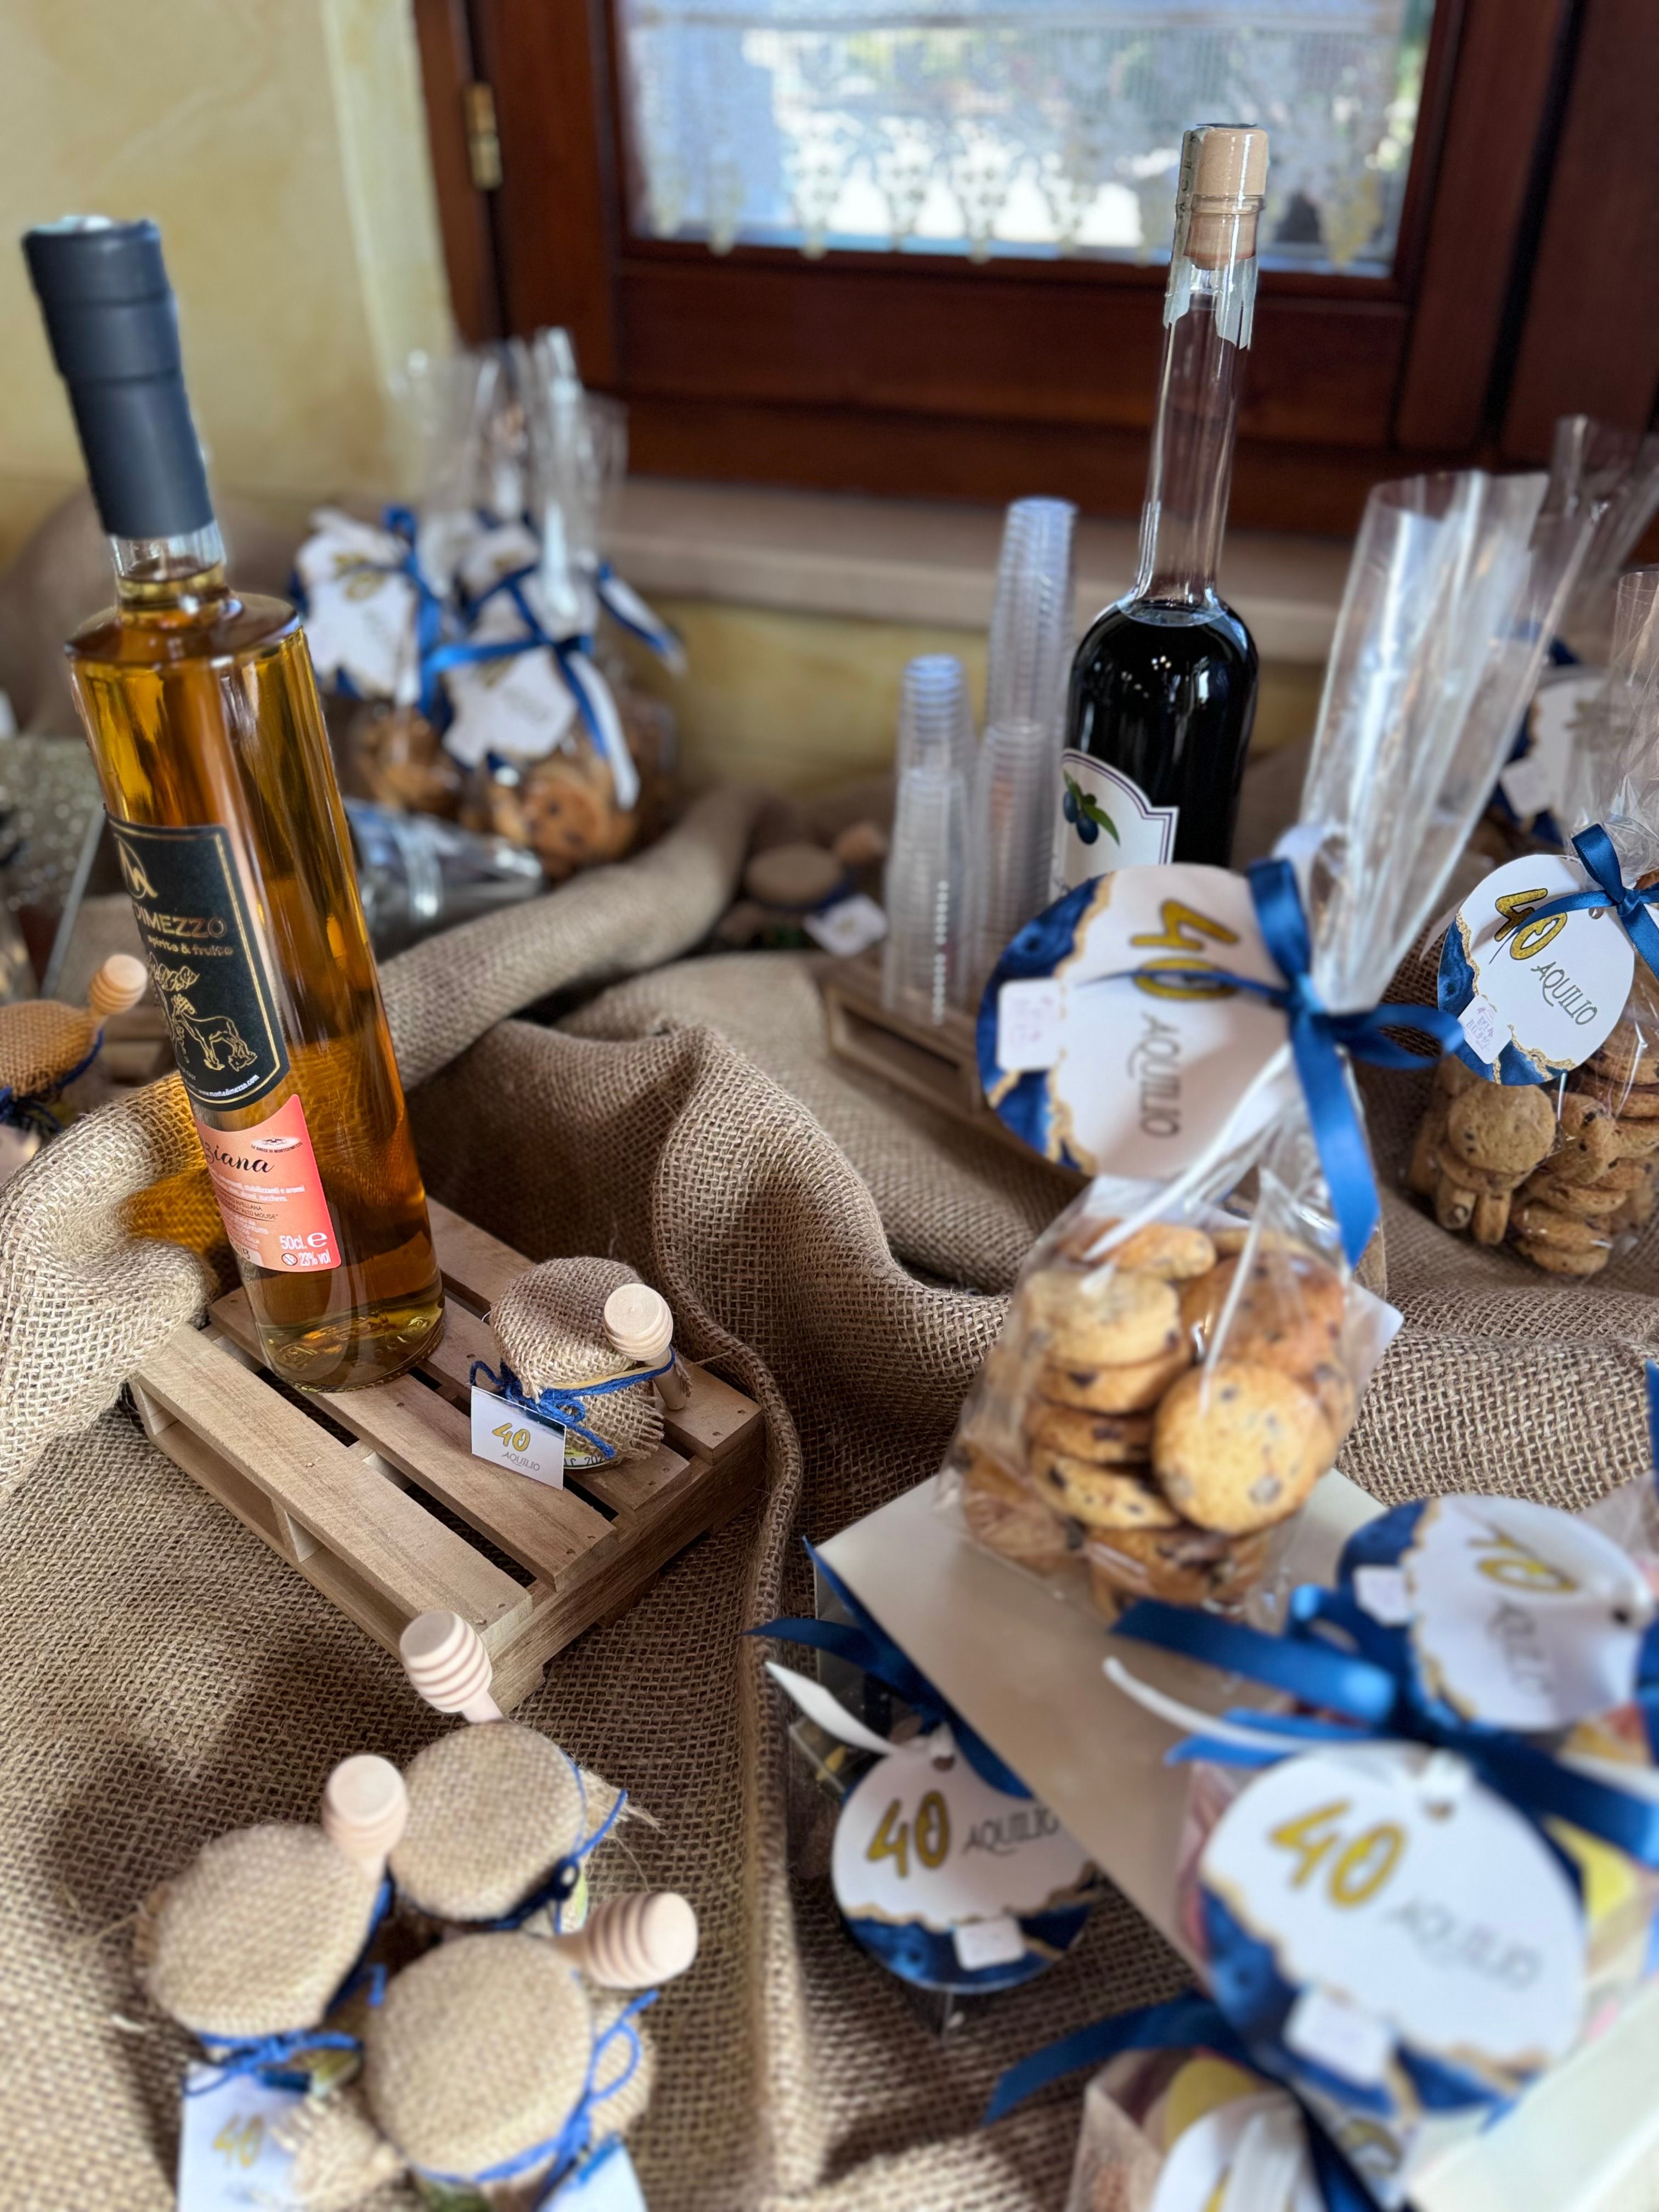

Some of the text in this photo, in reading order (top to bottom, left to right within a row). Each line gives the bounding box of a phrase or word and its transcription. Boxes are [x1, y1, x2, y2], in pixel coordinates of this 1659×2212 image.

[1495, 888, 1568, 960] 40
[180, 943, 191, 954] &
[1127, 899, 1240, 1000] 40
[1531, 961, 1598, 1025] AQUILIO
[1127, 1011, 1181, 1138] AQUILIO
[202, 1141, 275, 1173] ziana
[286, 1185, 306, 1193] aromi
[279, 1235, 307, 1250] 50cl.
[298, 1249, 332, 1266] 23% vol
[492, 1423, 531, 1452] 40
[501, 1452, 540, 1471] AQUILIO
[865, 1790, 1059, 1880] 40 AQUILIO
[1268, 1799, 1408, 1909] 40
